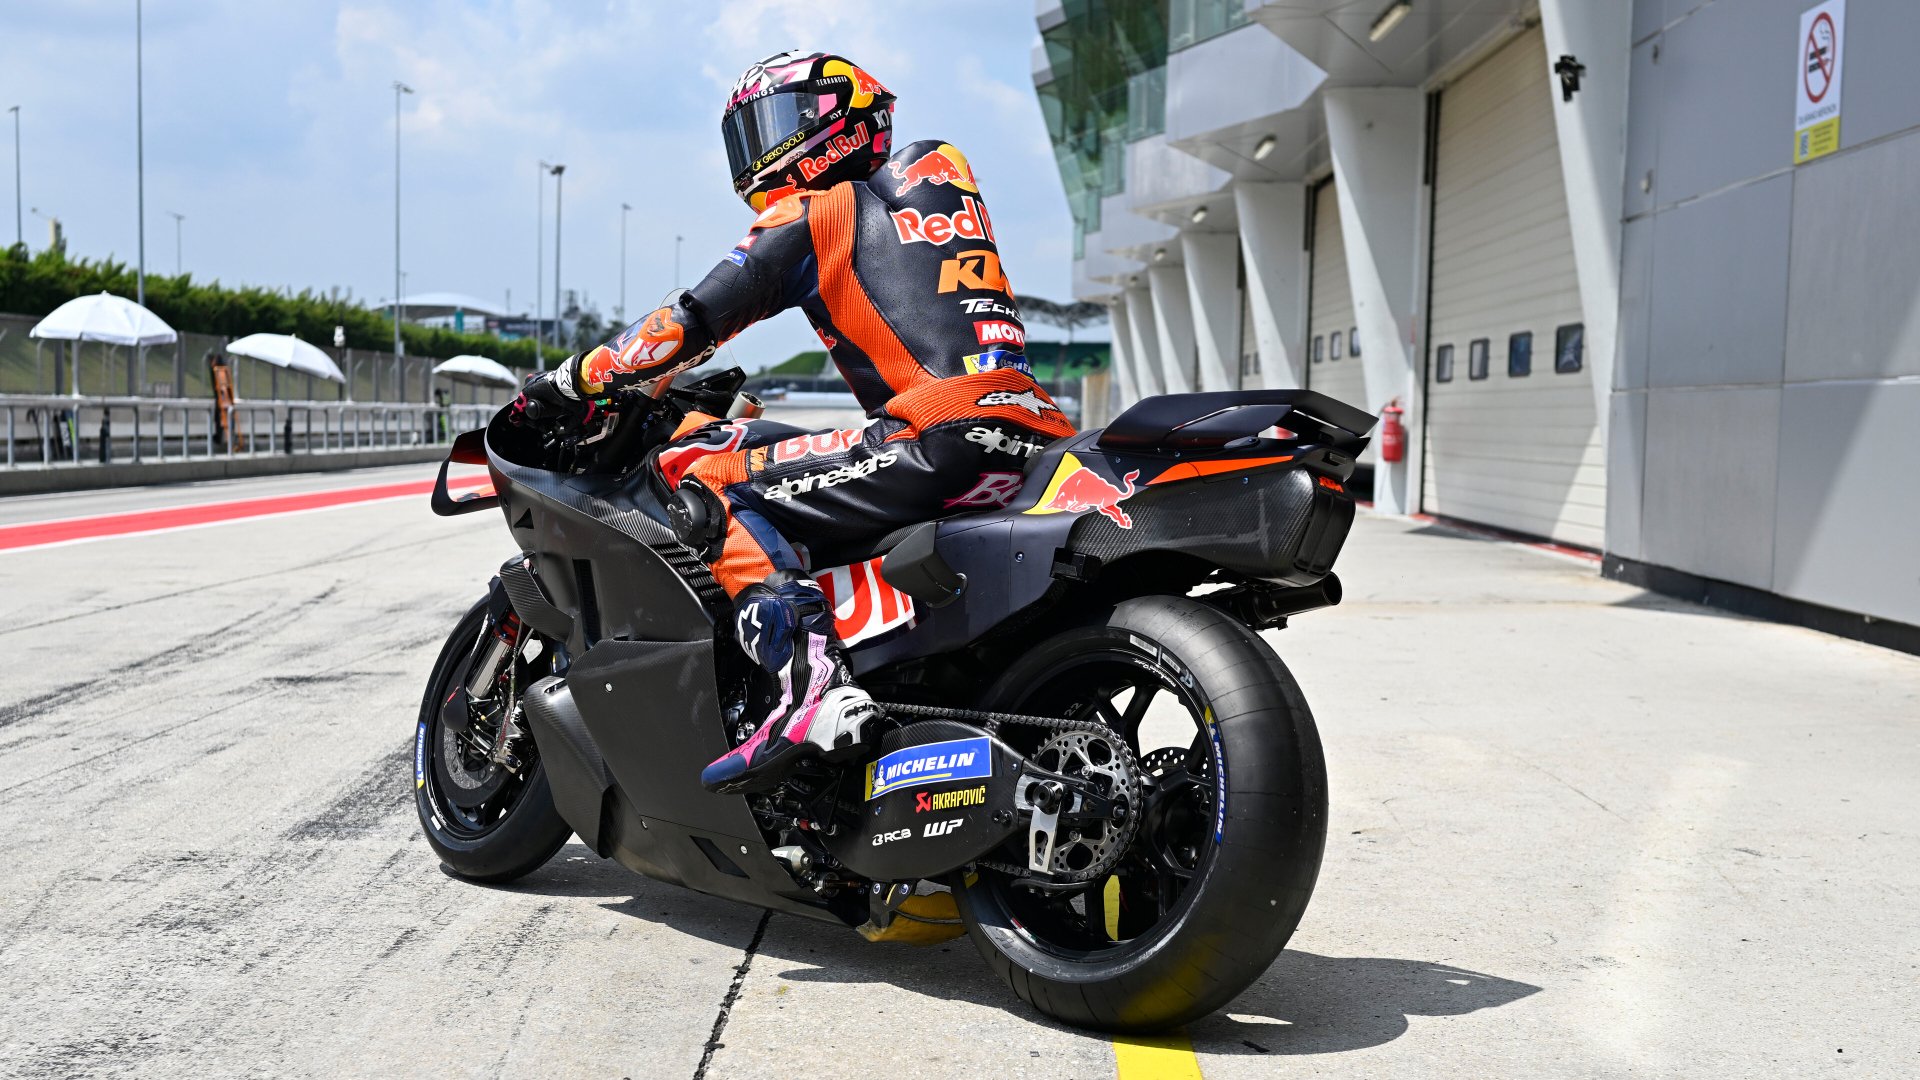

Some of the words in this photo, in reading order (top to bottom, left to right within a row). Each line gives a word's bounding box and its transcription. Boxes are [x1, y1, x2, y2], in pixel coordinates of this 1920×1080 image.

[740, 87, 775, 105] WINGS
[872, 108, 892, 130] KY
[797, 140, 843, 182] Red
[833, 121, 870, 157] Bull
[889, 195, 986, 246] Red
[981, 323, 1025, 346] MOT
[763, 449, 899, 502] alpinestars
[886, 752, 975, 780] MICHELIN
[1213, 741, 1226, 834] MICHELIN
